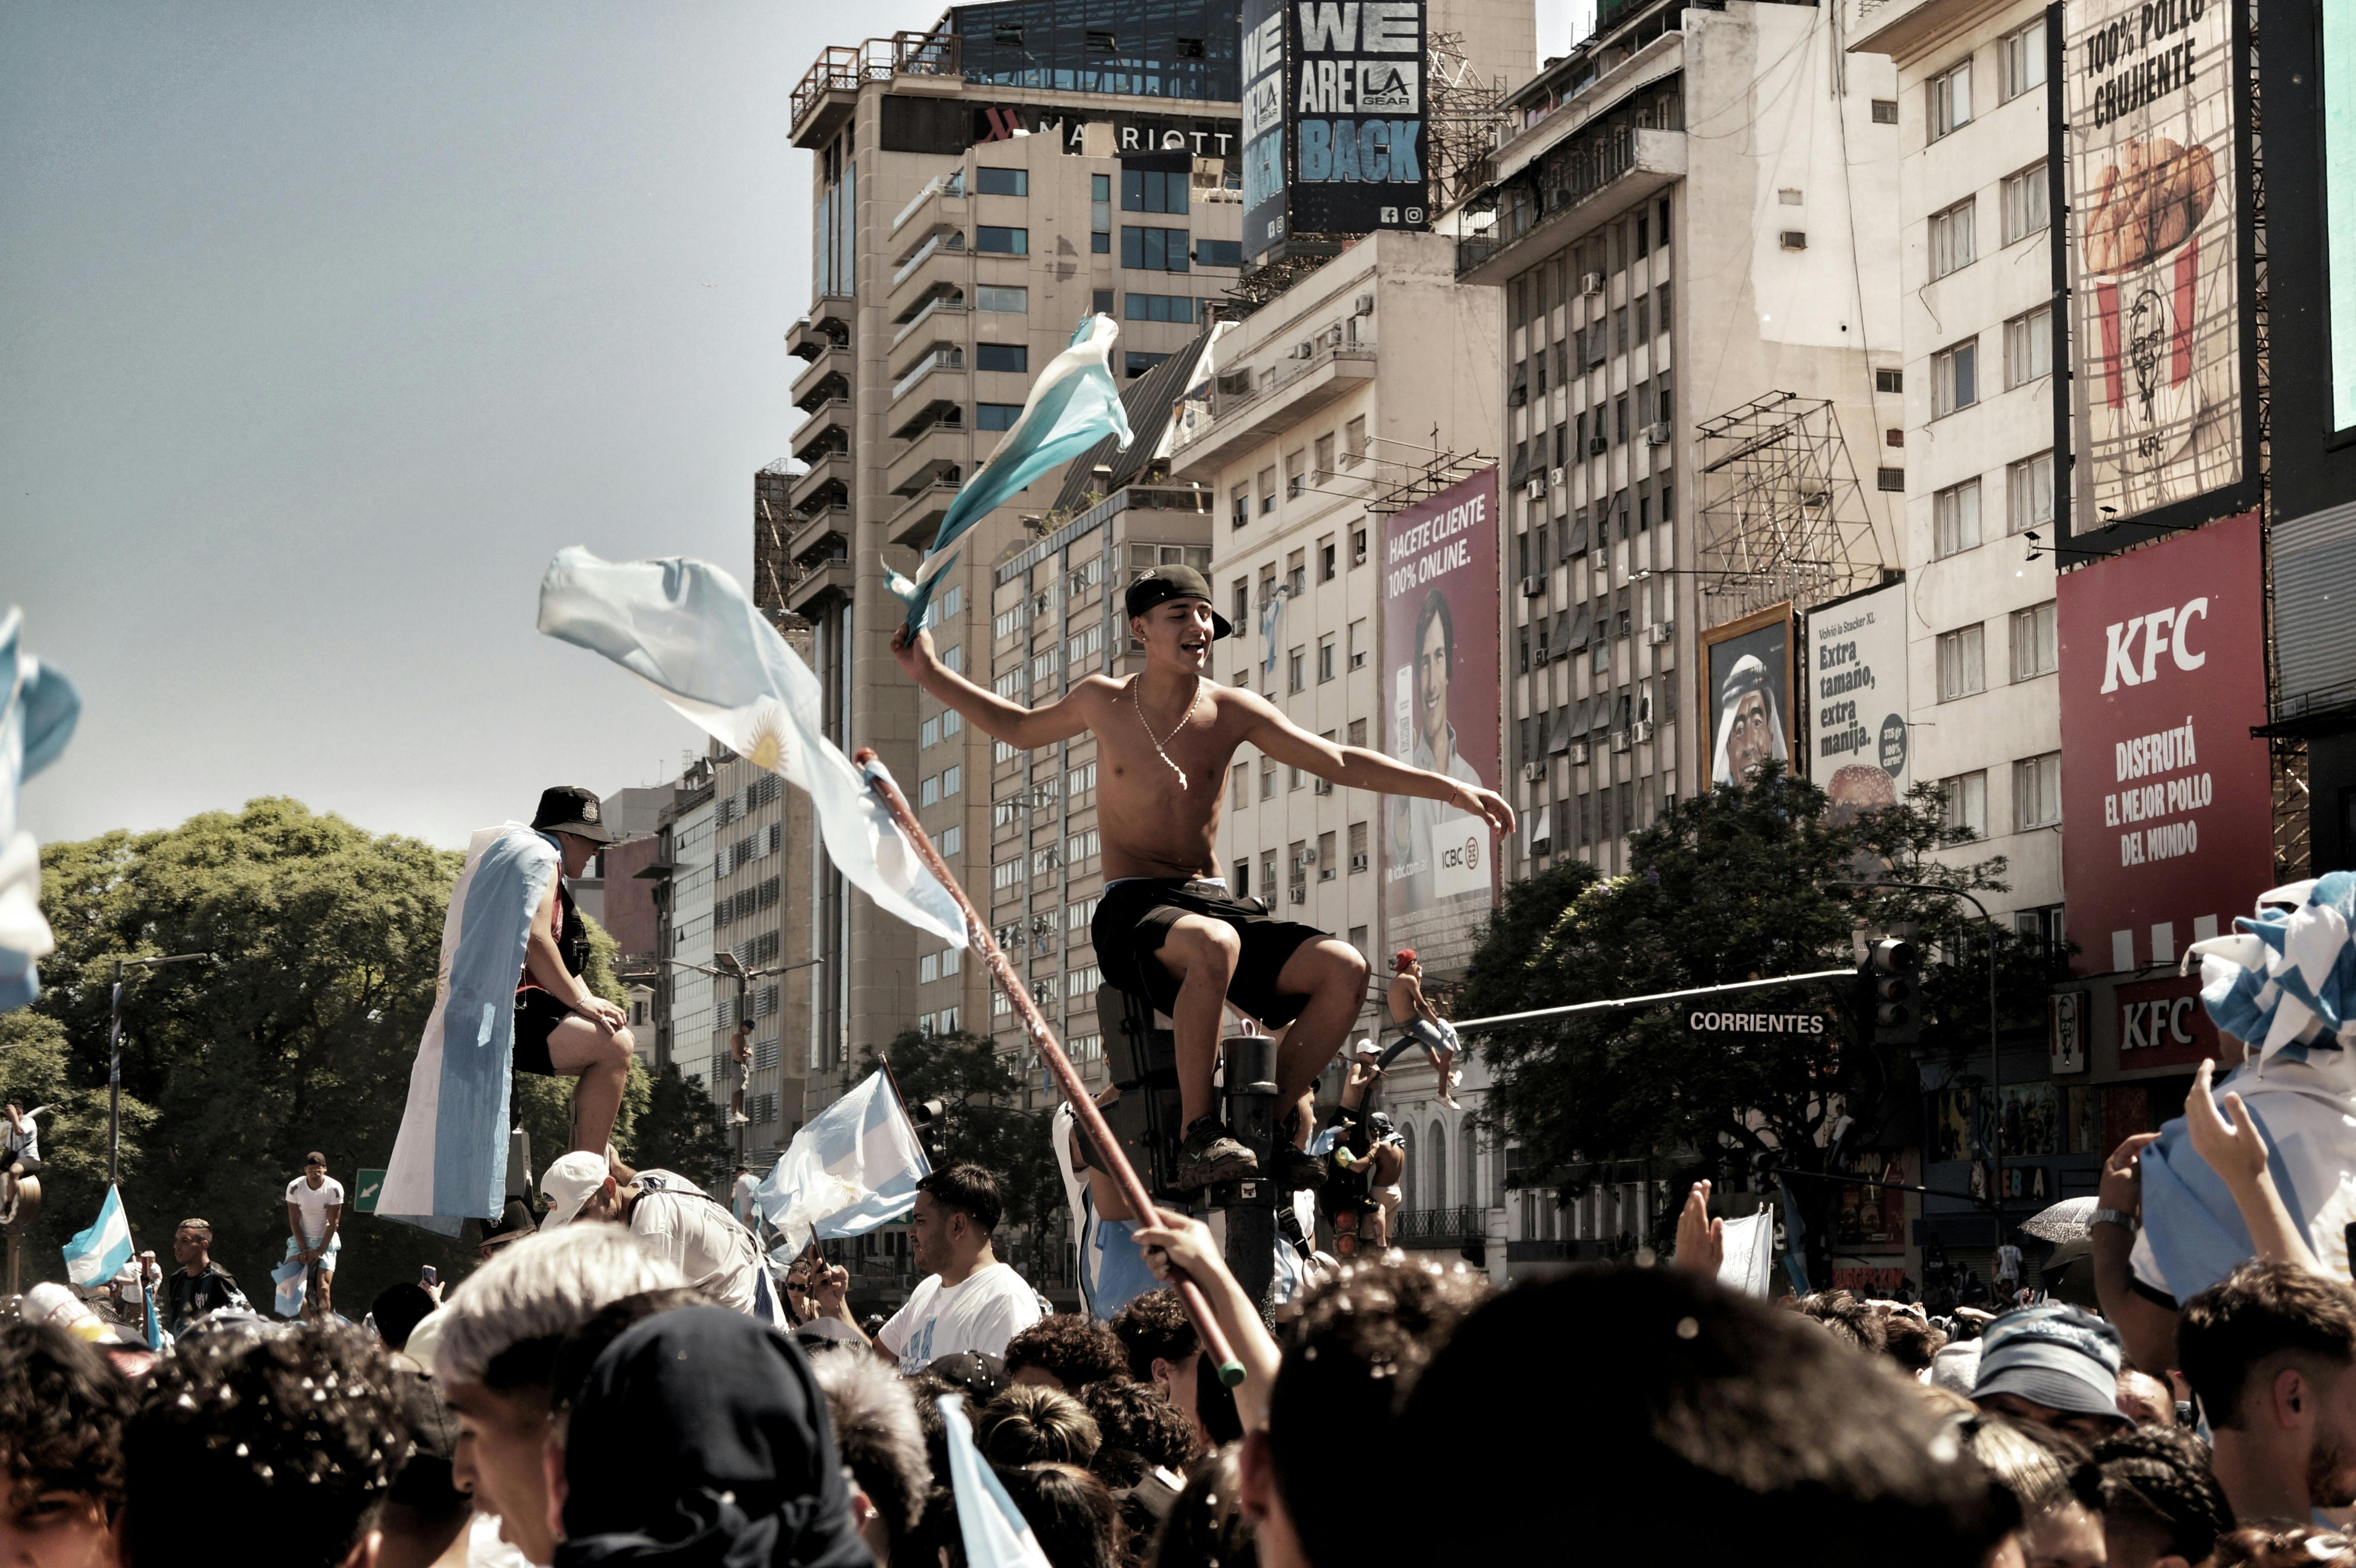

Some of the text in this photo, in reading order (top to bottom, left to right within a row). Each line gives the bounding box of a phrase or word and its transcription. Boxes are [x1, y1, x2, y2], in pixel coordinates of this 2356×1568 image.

[1242, 10, 1282, 86] WE
[1298, 2, 1419, 52] WE
[2087, 12, 2134, 78] 100%
[1259, 81, 1279, 115] LA
[1298, 60, 1415, 113] ARE LA
[1362, 97, 1410, 105] GEAR
[2094, 37, 2196, 130] CRUJIENTE
[1259, 108, 1277, 125] GEAR
[1298, 119, 1422, 184] BACK
[2138, 431, 2164, 458] KFC
[1389, 493, 1486, 565] HACETE CLIENTE
[1389, 538, 1471, 599] 100% ONLINE.
[1818, 611, 1876, 641] Volvió la Stacker XL
[2100, 597, 2208, 695] KFC
[1820, 641, 1857, 671] Extra
[1820, 660, 1875, 700] tamaño,
[1821, 699, 1856, 728] extra
[1821, 720, 1872, 758] manija.
[1885, 743, 1901, 756] 100%
[2116, 715, 2197, 783] DISFRUTÁ
[2105, 772, 2212, 828] EL MEJOR POLLO
[1441, 847, 1463, 869] ICBC
[2121, 819, 2198, 867] DEL MUNDO
[1690, 1012, 1824, 1034] CORRIENTES
[2121, 996, 2194, 1050] KFC
